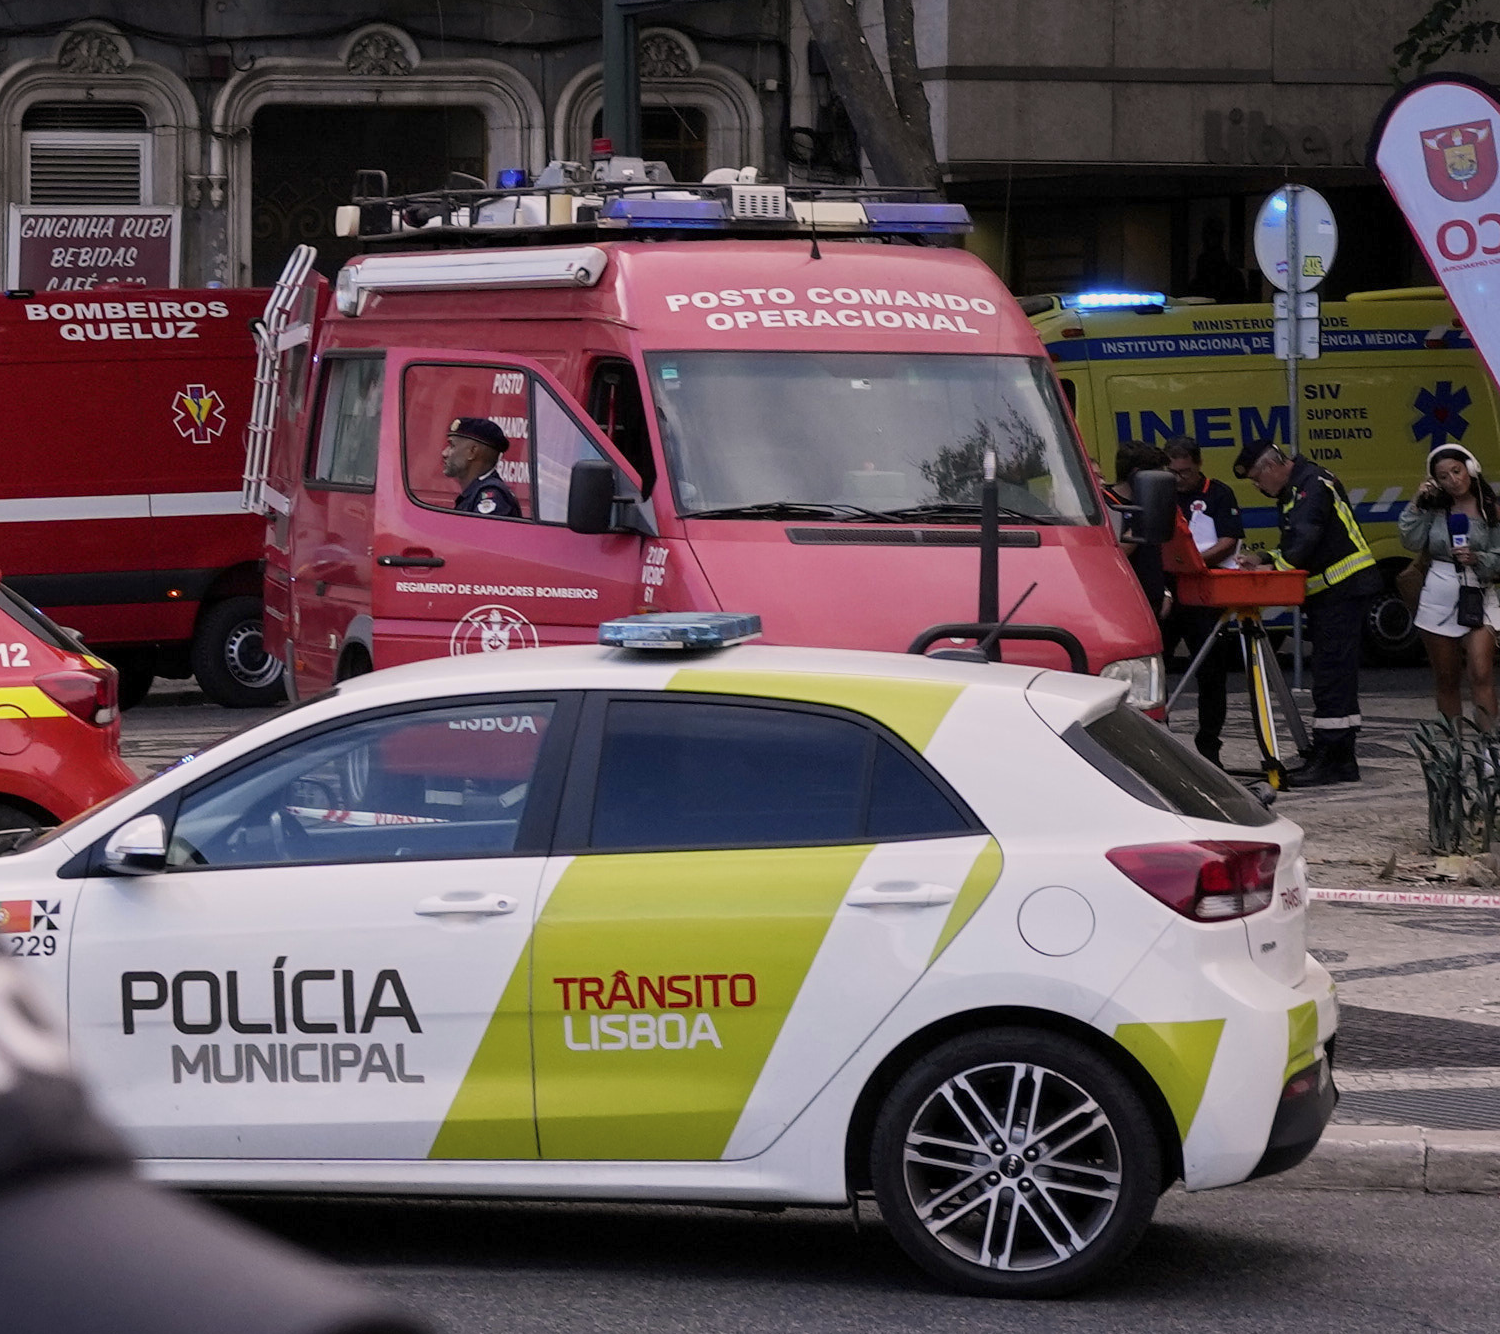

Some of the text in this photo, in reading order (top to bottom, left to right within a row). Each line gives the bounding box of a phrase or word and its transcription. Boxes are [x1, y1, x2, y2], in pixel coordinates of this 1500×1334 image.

[21, 216, 172, 240] GINGINHA RUBI
[50, 246, 139, 268] BEBIDAS
[24, 300, 230, 321] BOMBEIROS
[665, 287, 997, 316] POSTO COMANDO
[59, 321, 200, 342] QUELUZ
[705, 309, 980, 335] OPERACIONAL
[1102, 338, 1175, 354] INSTITUTO
[1179, 337, 1246, 353] NACIONAL
[1252, 336, 1270, 349] DE
[1365, 330, 1417, 346] MÉDICA
[492, 373, 524, 395] POSTO
[1304, 383, 1341, 400] SIV
[1306, 407, 1368, 420] SUPORTE
[1115, 405, 1291, 448] INEM
[1309, 427, 1372, 441] IMEDIATO
[1310, 447, 1342, 461] VIDA
[396, 581, 599, 600] REGIMENTO DE SAPADORES BOMBEIROS
[10, 934, 57, 957] 229
[120, 955, 423, 1036] POLÍCIA
[553, 969, 757, 1011] TRÂNSITO
[563, 1012, 723, 1052] LISBOA
[171, 1042, 425, 1084] MUNICIPAL
